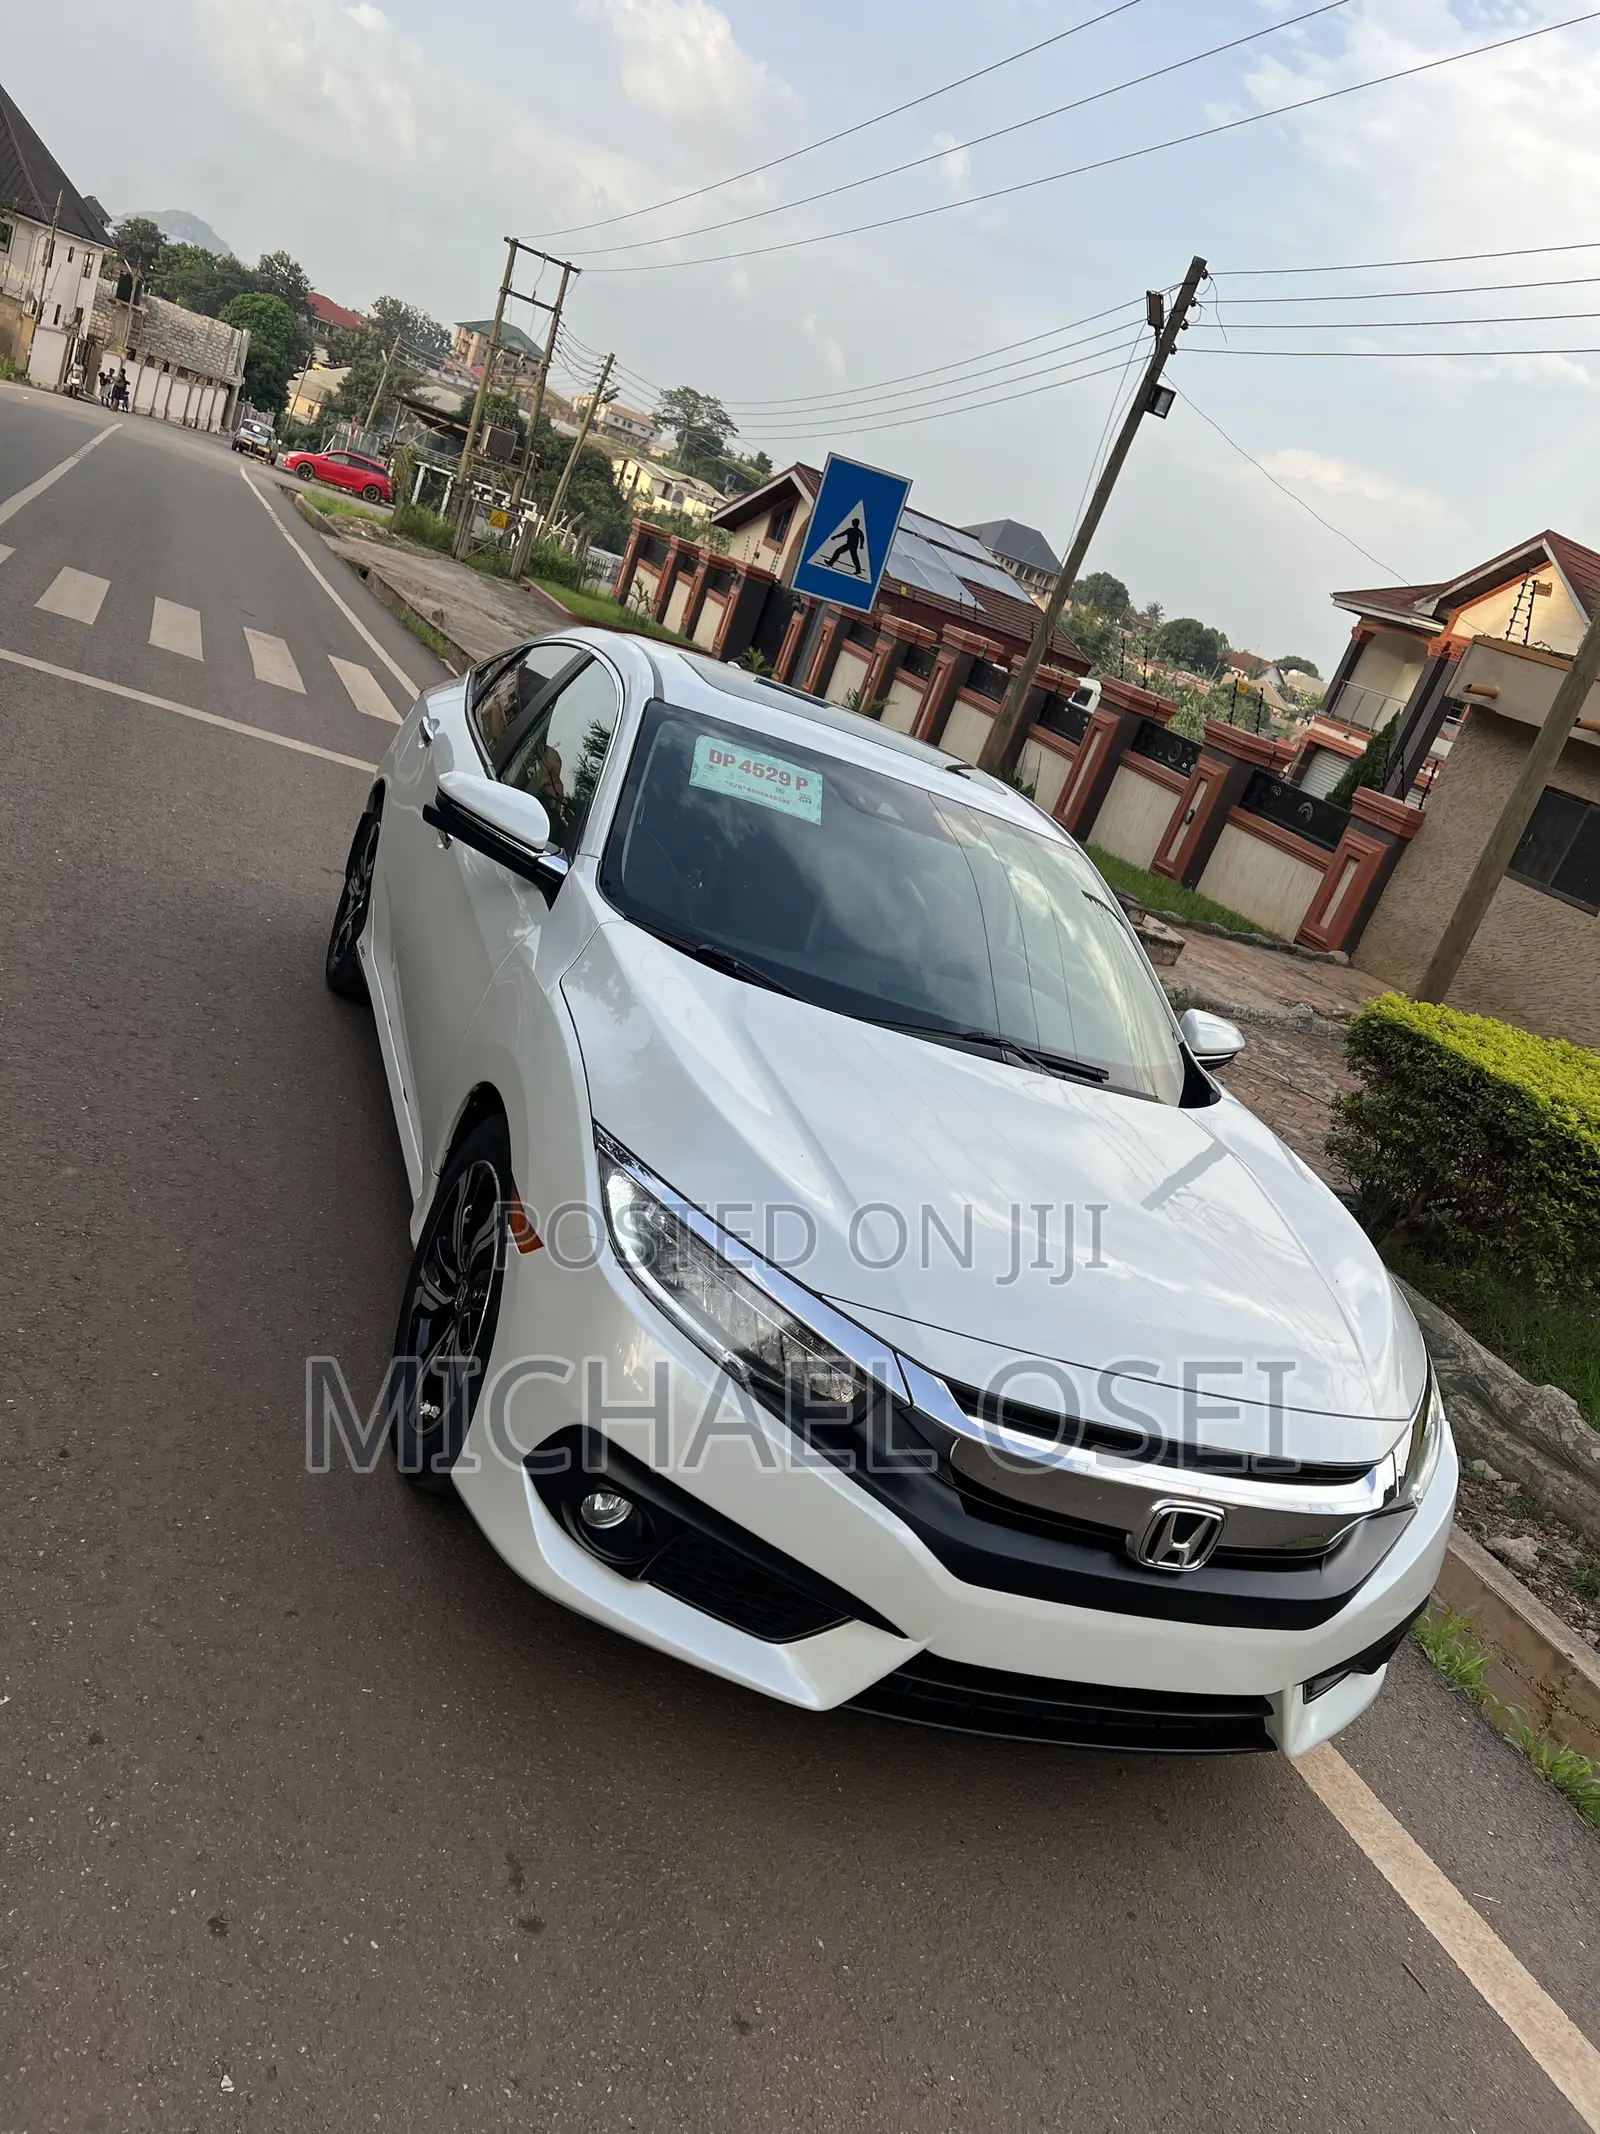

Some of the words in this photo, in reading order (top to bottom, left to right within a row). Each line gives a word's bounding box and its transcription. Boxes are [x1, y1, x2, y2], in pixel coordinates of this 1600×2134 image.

[709, 748, 736, 768] DP
[738, 759, 791, 786] 4529
[796, 776, 809, 790] P
